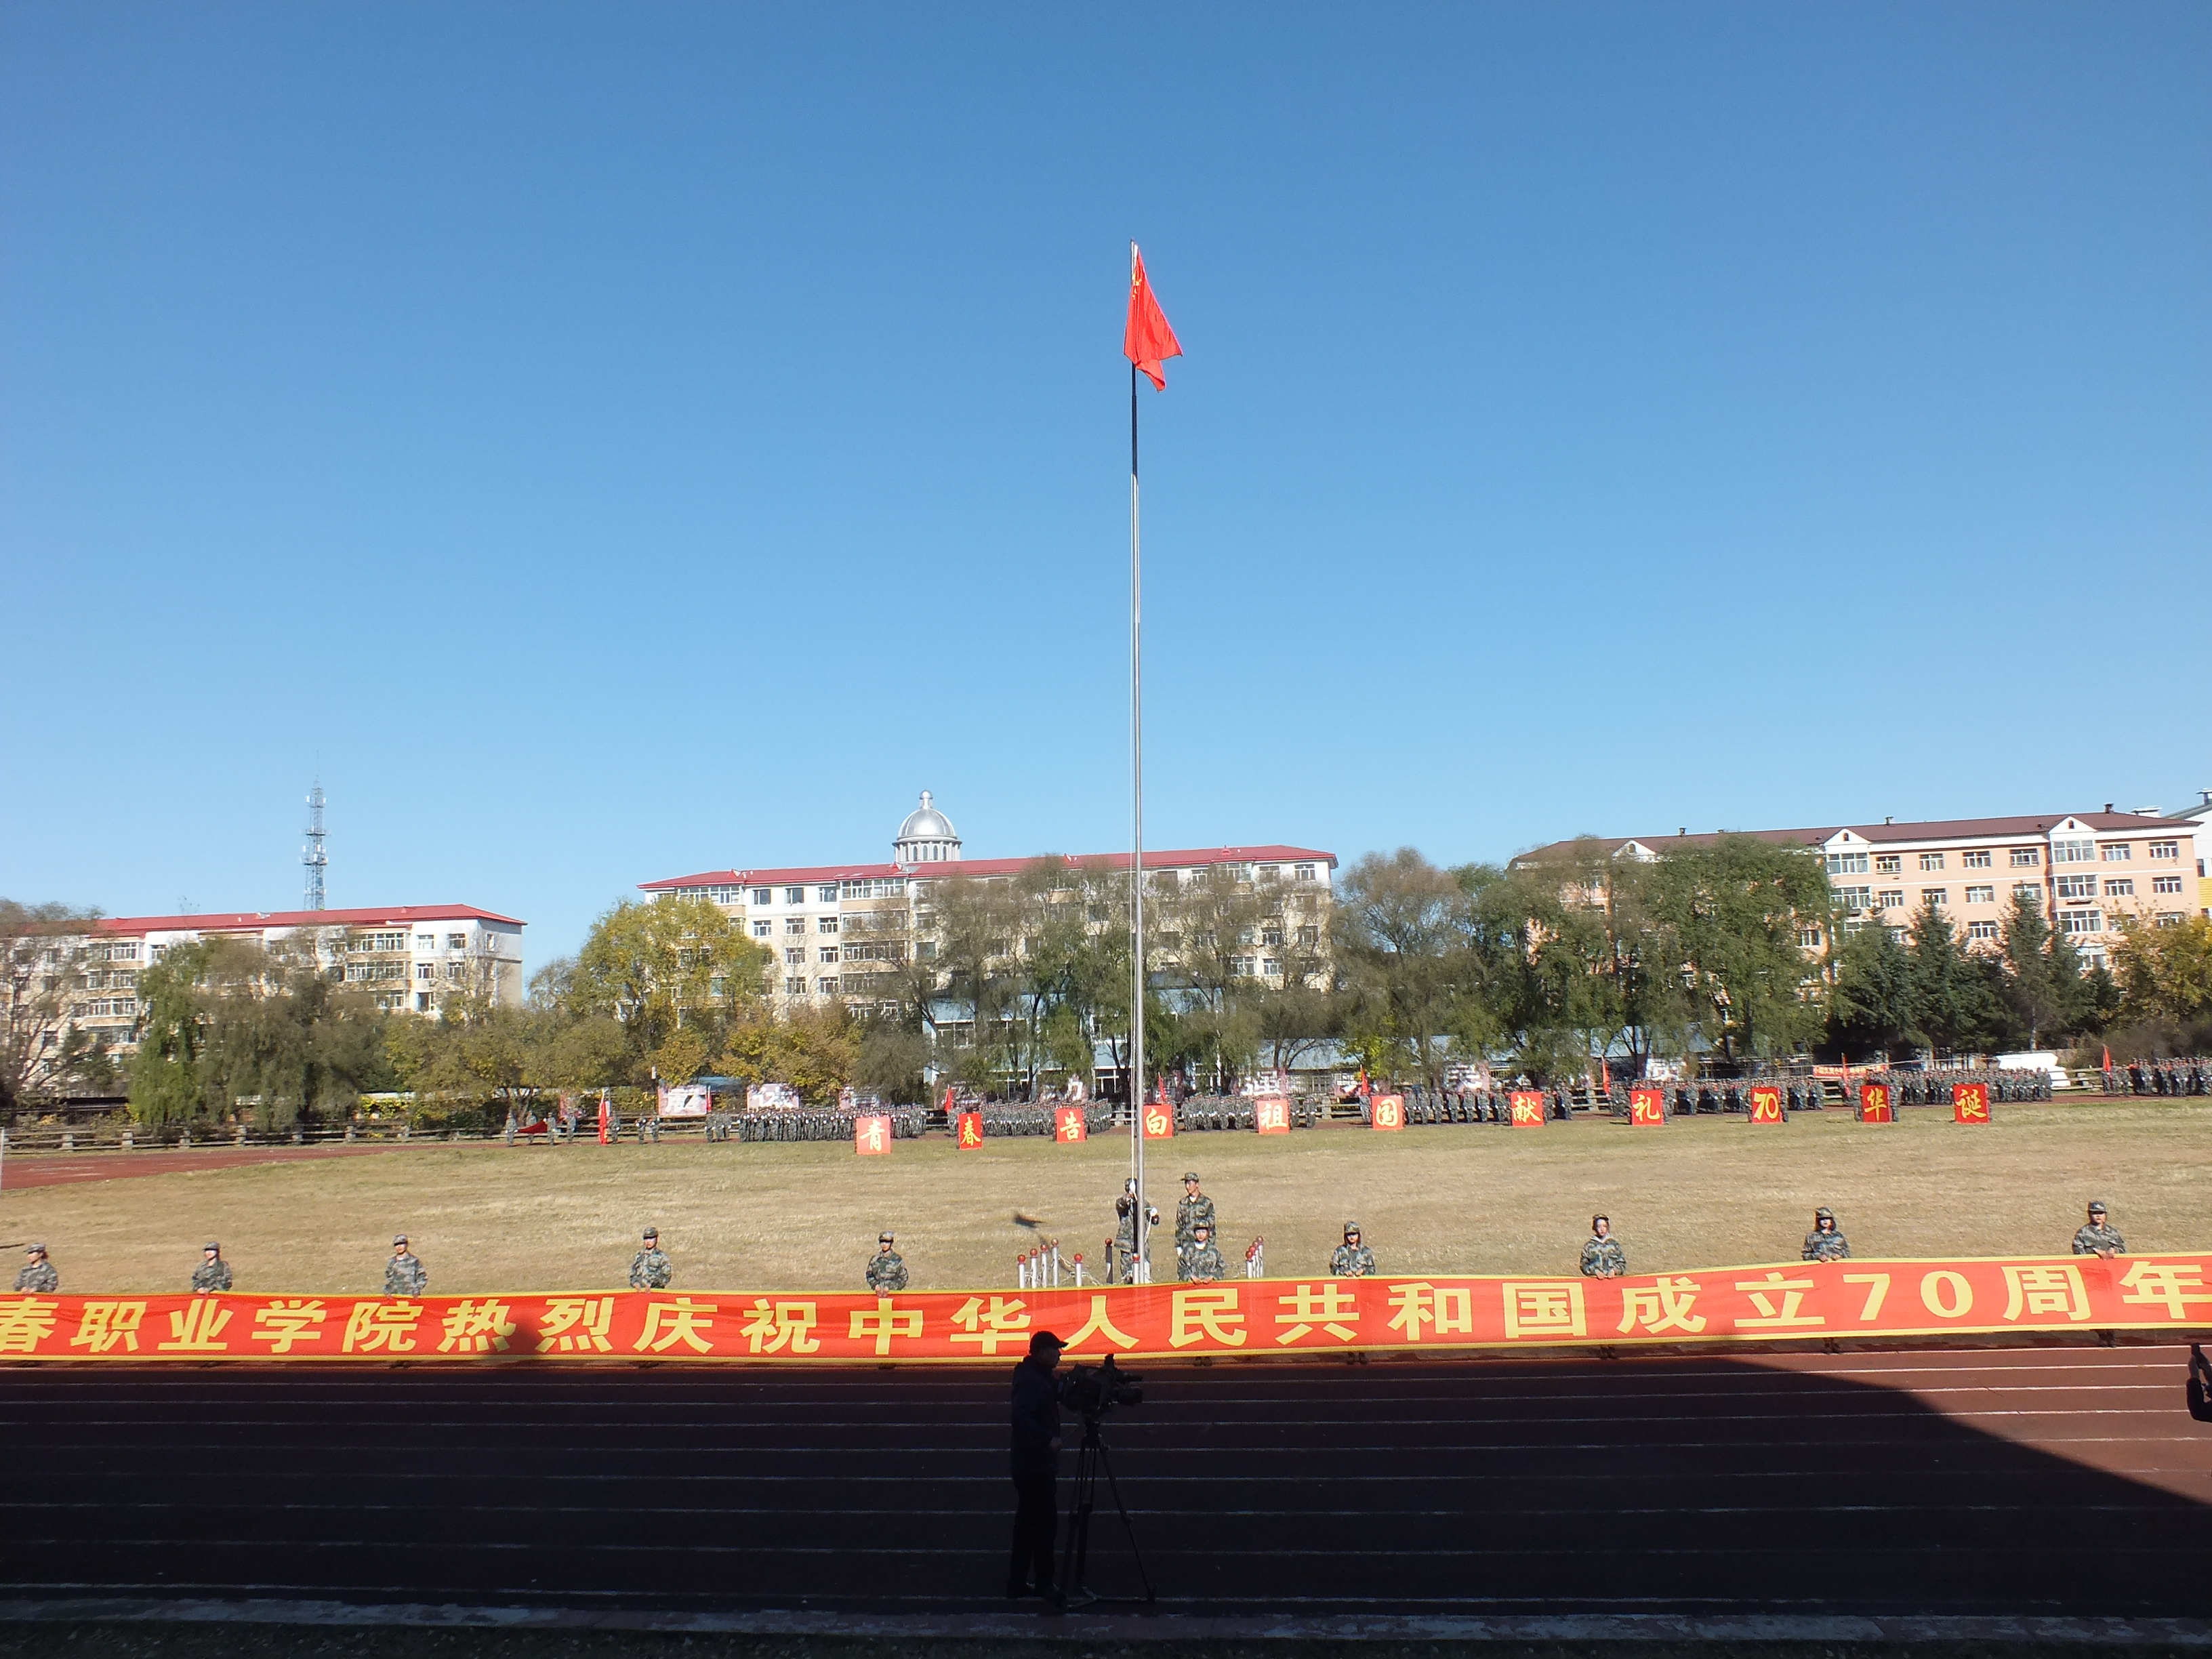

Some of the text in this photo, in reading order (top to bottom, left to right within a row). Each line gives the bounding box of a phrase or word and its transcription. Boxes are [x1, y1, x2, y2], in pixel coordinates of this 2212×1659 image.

[1259, 1103, 1288, 1131] 祖
[1376, 1099, 1399, 1126] 国
[1511, 1094, 1542, 1123] 献
[1632, 1094, 1661, 1122] 礼
[1753, 1092, 1779, 1120] 70
[1864, 1088, 1887, 1121] 华
[1956, 1088, 1986, 1118] 诞
[859, 1119, 885, 1151] 青
[961, 1116, 981, 1146] 春
[1059, 1111, 1082, 1141] 告
[1145, 1107, 1168, 1135] 白
[0, 1261, 2212, 1354] 春职业学院热烈庆祝中华人民共和国成立70周年
